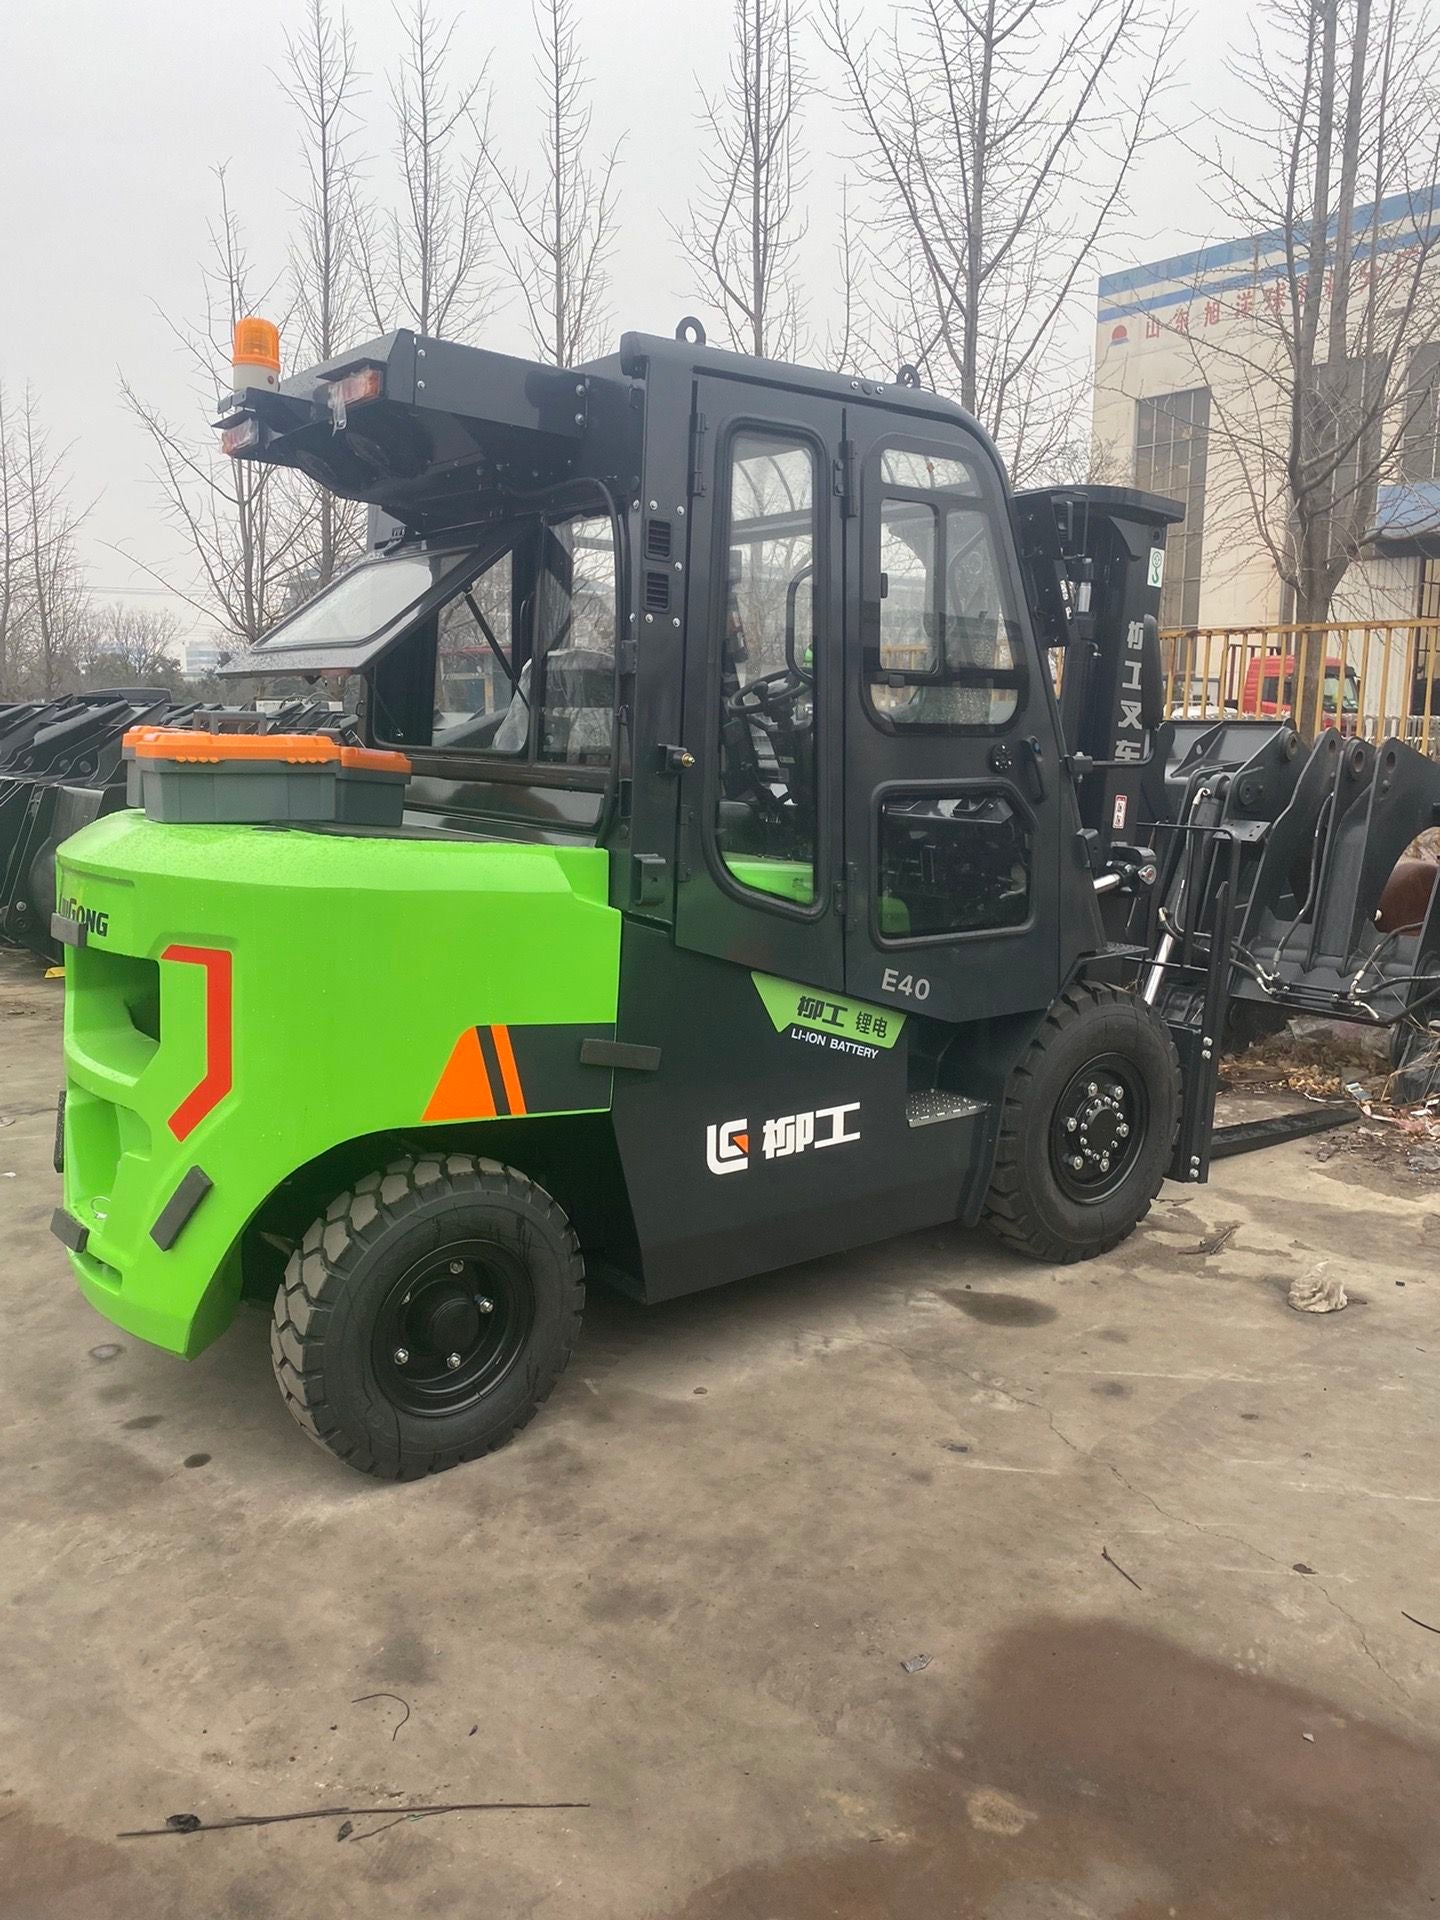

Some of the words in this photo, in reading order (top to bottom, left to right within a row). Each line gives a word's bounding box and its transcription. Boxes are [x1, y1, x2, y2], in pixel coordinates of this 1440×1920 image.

[881, 968, 930, 1000] E40
[797, 995, 848, 1028] 柳工
[856, 1011, 888, 1038] 锂电
[791, 1028, 826, 1046] LI-ION
[830, 1038, 879, 1060] BATTERY
[762, 1101, 861, 1160] 柳工
